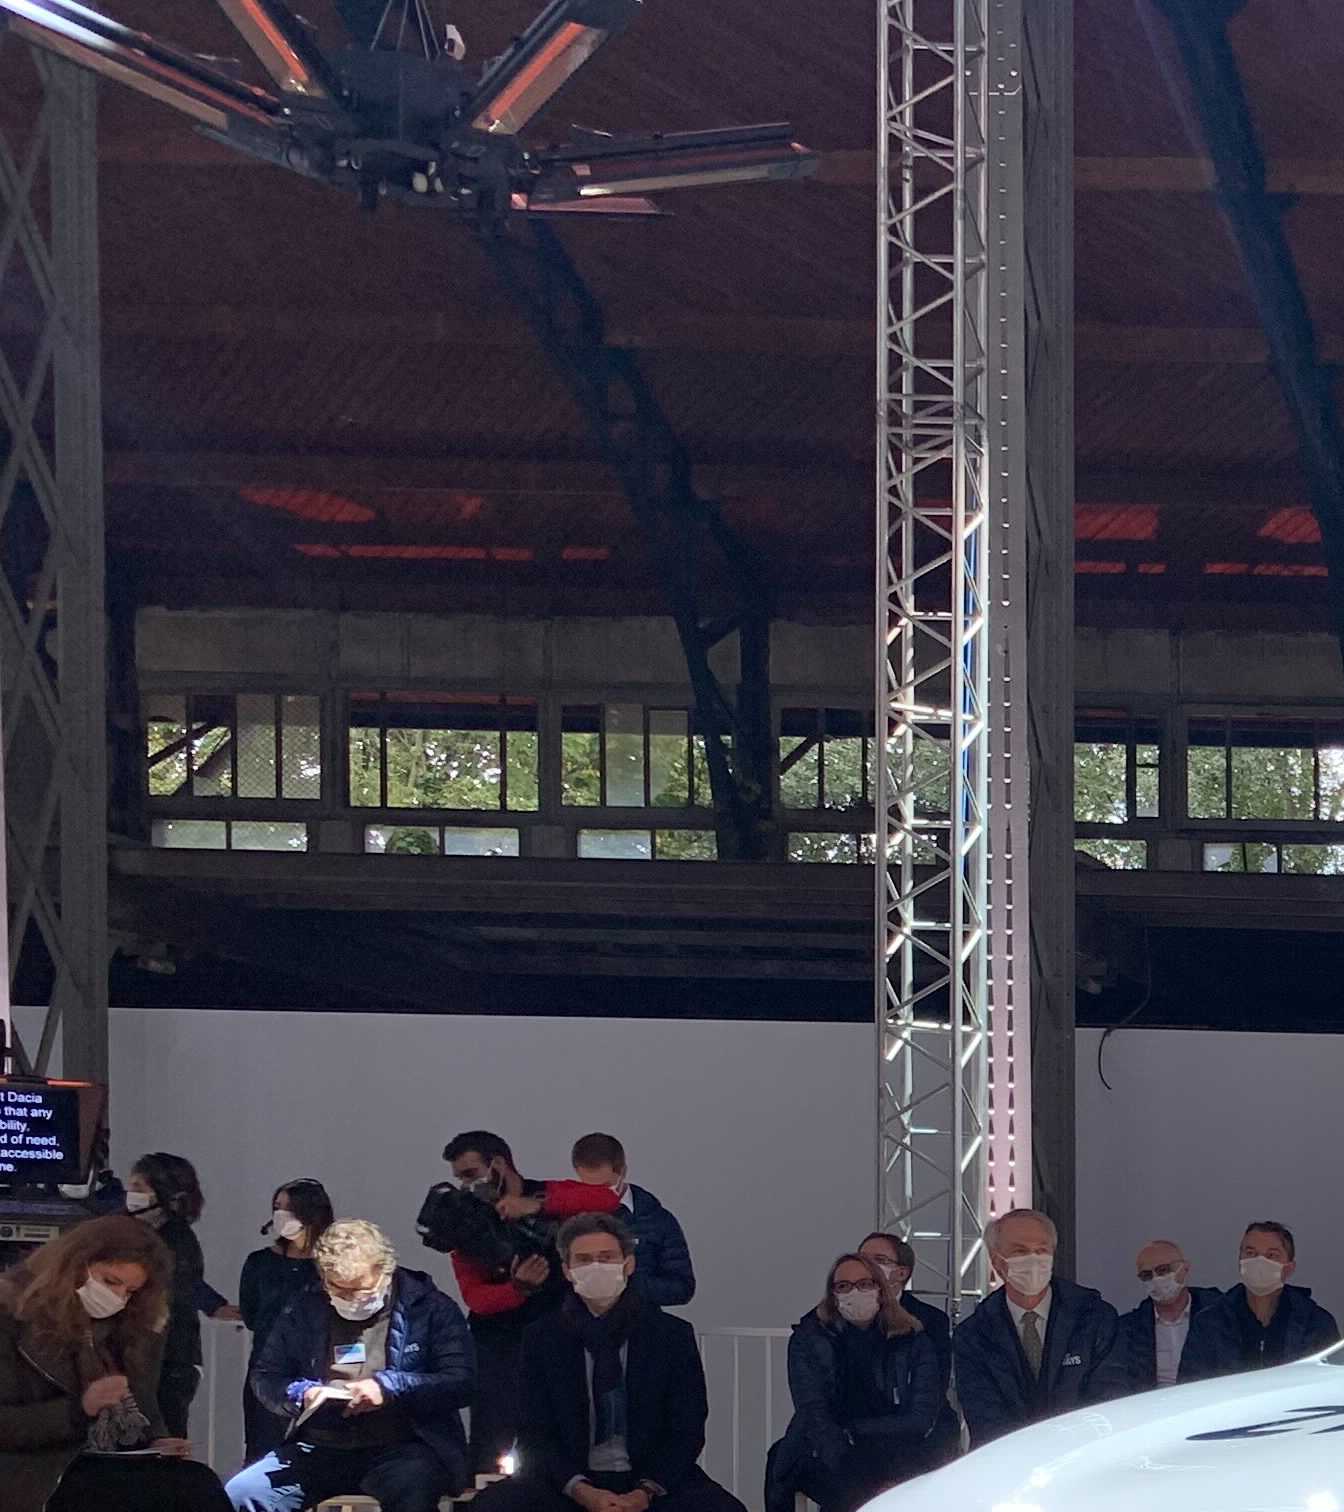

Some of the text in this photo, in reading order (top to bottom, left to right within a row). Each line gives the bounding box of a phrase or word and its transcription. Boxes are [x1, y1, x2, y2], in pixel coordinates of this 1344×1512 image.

[7, 1091, 43, 1104] Dacia
[4, 1106, 53, 1120] that any
[11, 1134, 23, 1144] of
[26, 1135, 60, 1147] need.
[0, 1148, 64, 1160] accessible
